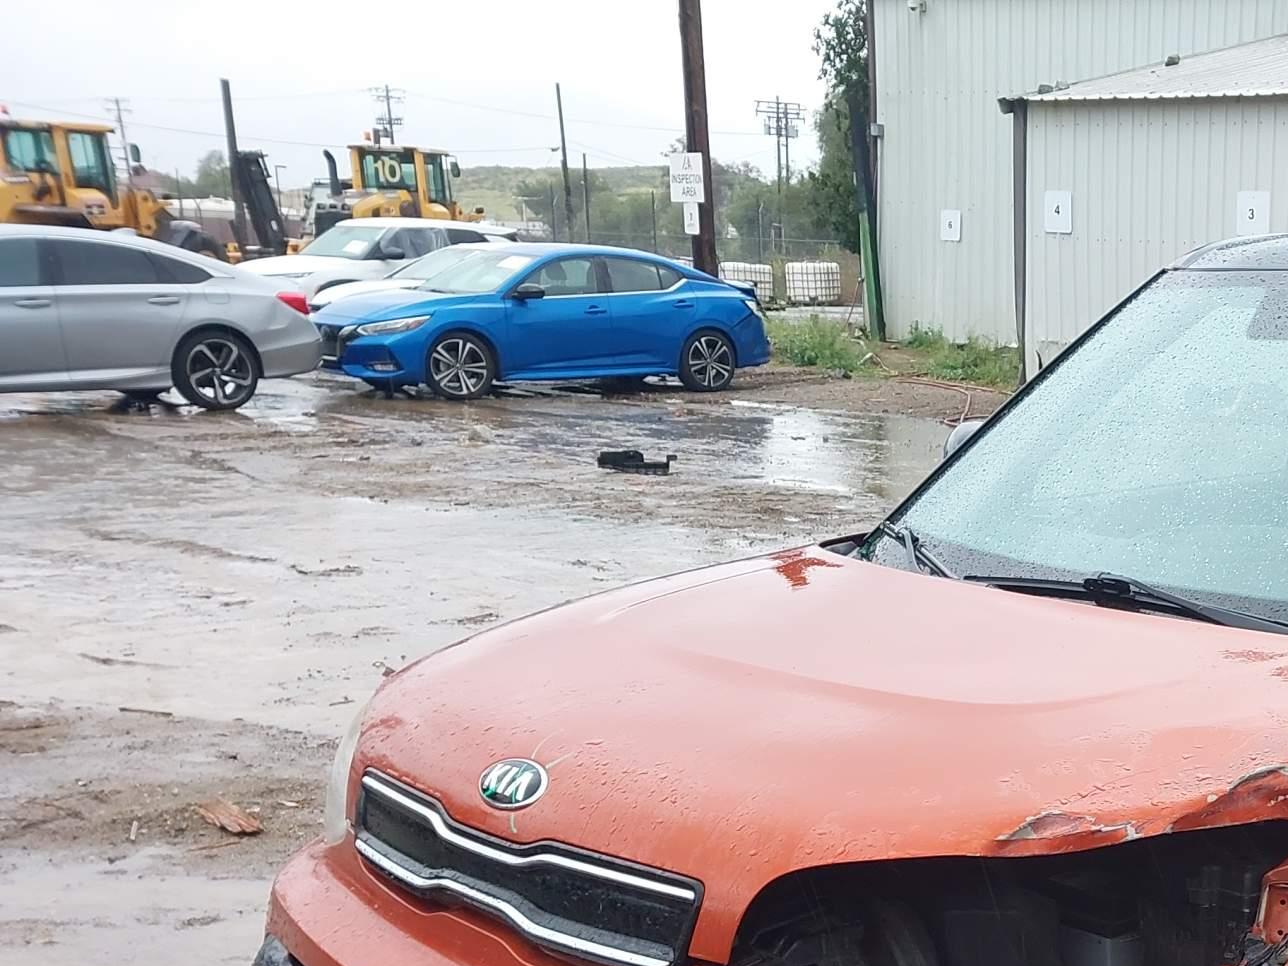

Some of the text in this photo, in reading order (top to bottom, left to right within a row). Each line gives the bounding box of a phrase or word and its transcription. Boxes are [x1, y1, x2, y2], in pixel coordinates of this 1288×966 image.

[1054, 204, 1060, 215] 4
[1247, 207, 1255, 220] 3
[482, 762, 534, 802] KIA
